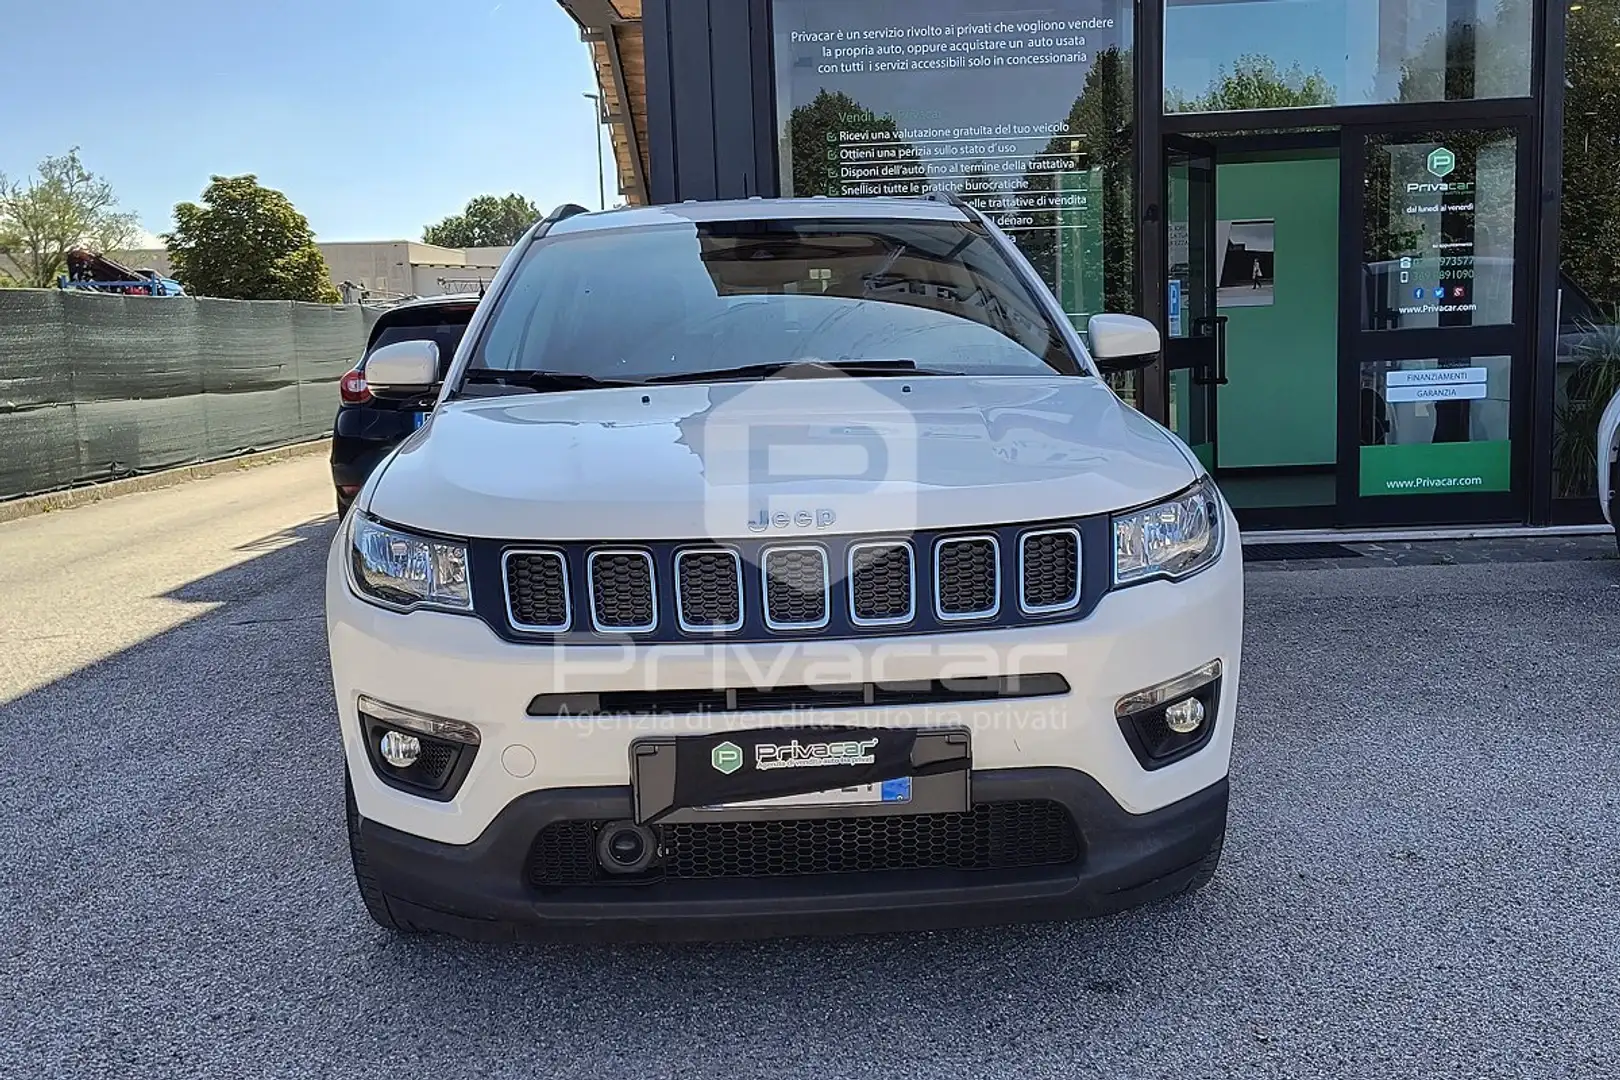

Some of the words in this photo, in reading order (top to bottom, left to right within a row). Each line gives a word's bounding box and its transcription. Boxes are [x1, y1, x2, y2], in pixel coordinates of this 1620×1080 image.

[791, 31, 834, 42] Privacar
[837, 30, 844, 40] è
[846, 31, 861, 40] un
[863, 27, 905, 39] servizio
[907, 25, 942, 38] rivolto
[944, 24, 955, 36] ai
[957, 23, 992, 37] privati
[994, 21, 1014, 33] che
[1017, 20, 1066, 34] vogliono
[1068, 17, 1114, 30] vendere
[822, 46, 832, 57] la
[834, 45, 874, 59] propria
[876, 44, 905, 55] auto,
[907, 42, 948, 56] oppure
[950, 39, 1007, 53] acquistare
[1008, 39, 1023, 49] un
[1027, 37, 1053, 48] auto
[1055, 35, 1086, 46] usata
[818, 63, 838, 74] con
[840, 61, 864, 73] tutti
[874, 59, 909, 72] servizi
[911, 56, 966, 69] accessibili
[968, 55, 991, 67] solo
[993, 55, 1003, 65] in
[1006, 51, 1087, 66] concessionaria
[839, 111, 871, 123] Vendi
[840, 130, 869, 141] Ricevi
[870, 131, 891, 140] una
[892, 128, 951, 139] valutazione
[953, 126, 992, 138] gratuita
[995, 124, 1011, 135] del
[1013, 124, 1031, 134] tuo
[1033, 122, 1070, 133] veicolo
[840, 148, 875, 160] Ottieni
[877, 148, 896, 158] una
[899, 146, 931, 158] perizia
[934, 144, 958, 155] sullo
[960, 143, 986, 154] stato
[841, 166, 879, 178] Disponi
[881, 164, 925, 176] dell'auto
[927, 163, 947, 174] fino
[949, 163, 958, 173] al
[960, 161, 1000, 173] termine
[1002, 159, 1026, 171] della
[1028, 158, 1075, 170] trattativa
[841, 182, 881, 196] Snellisci
[883, 183, 908, 194] tutte
[910, 182, 920, 192] le
[922, 181, 964, 194] pratiche
[965, 178, 1029, 190] burocratiche
[1406, 182, 1475, 193] Privacar
[988, 197, 1035, 208] trattative
[1036, 195, 1046, 206] di
[1048, 194, 1087, 205] vendita
[1406, 205, 1417, 214] dal
[1440, 203, 1447, 212] al
[997, 214, 1033, 226] denaro
[1399, 303, 1477, 314] www.Privacar.com
[1406, 372, 1468, 382] FINANZIAMENTI
[1416, 388, 1457, 398] GARANZIA
[1386, 475, 1482, 489] www.Privacar.com
[747, 508, 836, 532] Jeep
[755, 738, 878, 760] Privacar
